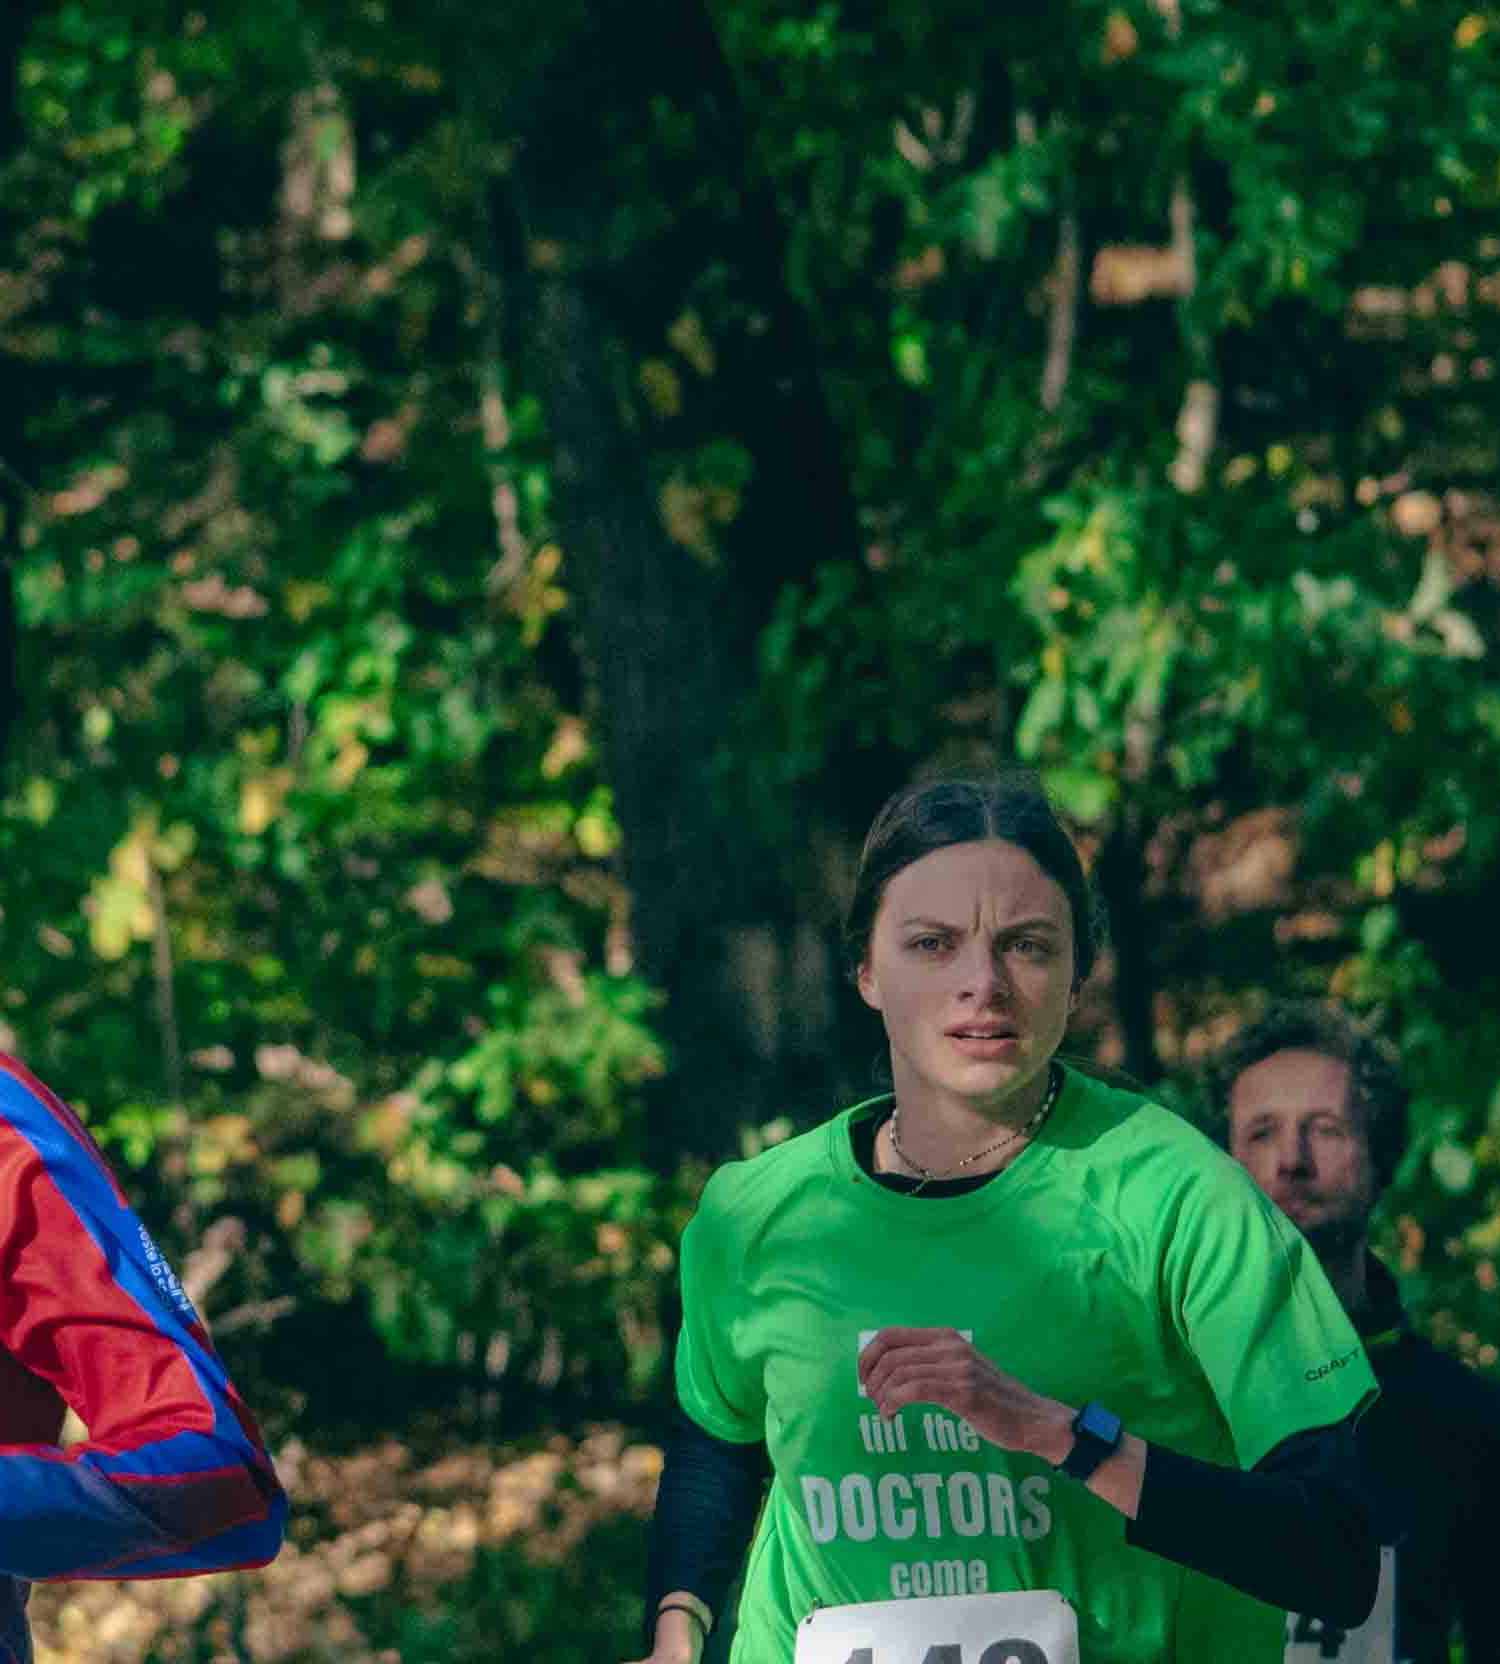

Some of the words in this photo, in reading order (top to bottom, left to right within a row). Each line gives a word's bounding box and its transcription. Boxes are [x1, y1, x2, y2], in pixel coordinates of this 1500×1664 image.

[859, 1414, 907, 1453] till
[923, 1413, 980, 1452] the
[801, 1471, 1052, 1543] DOCTORS
[890, 1558, 989, 1597] come
